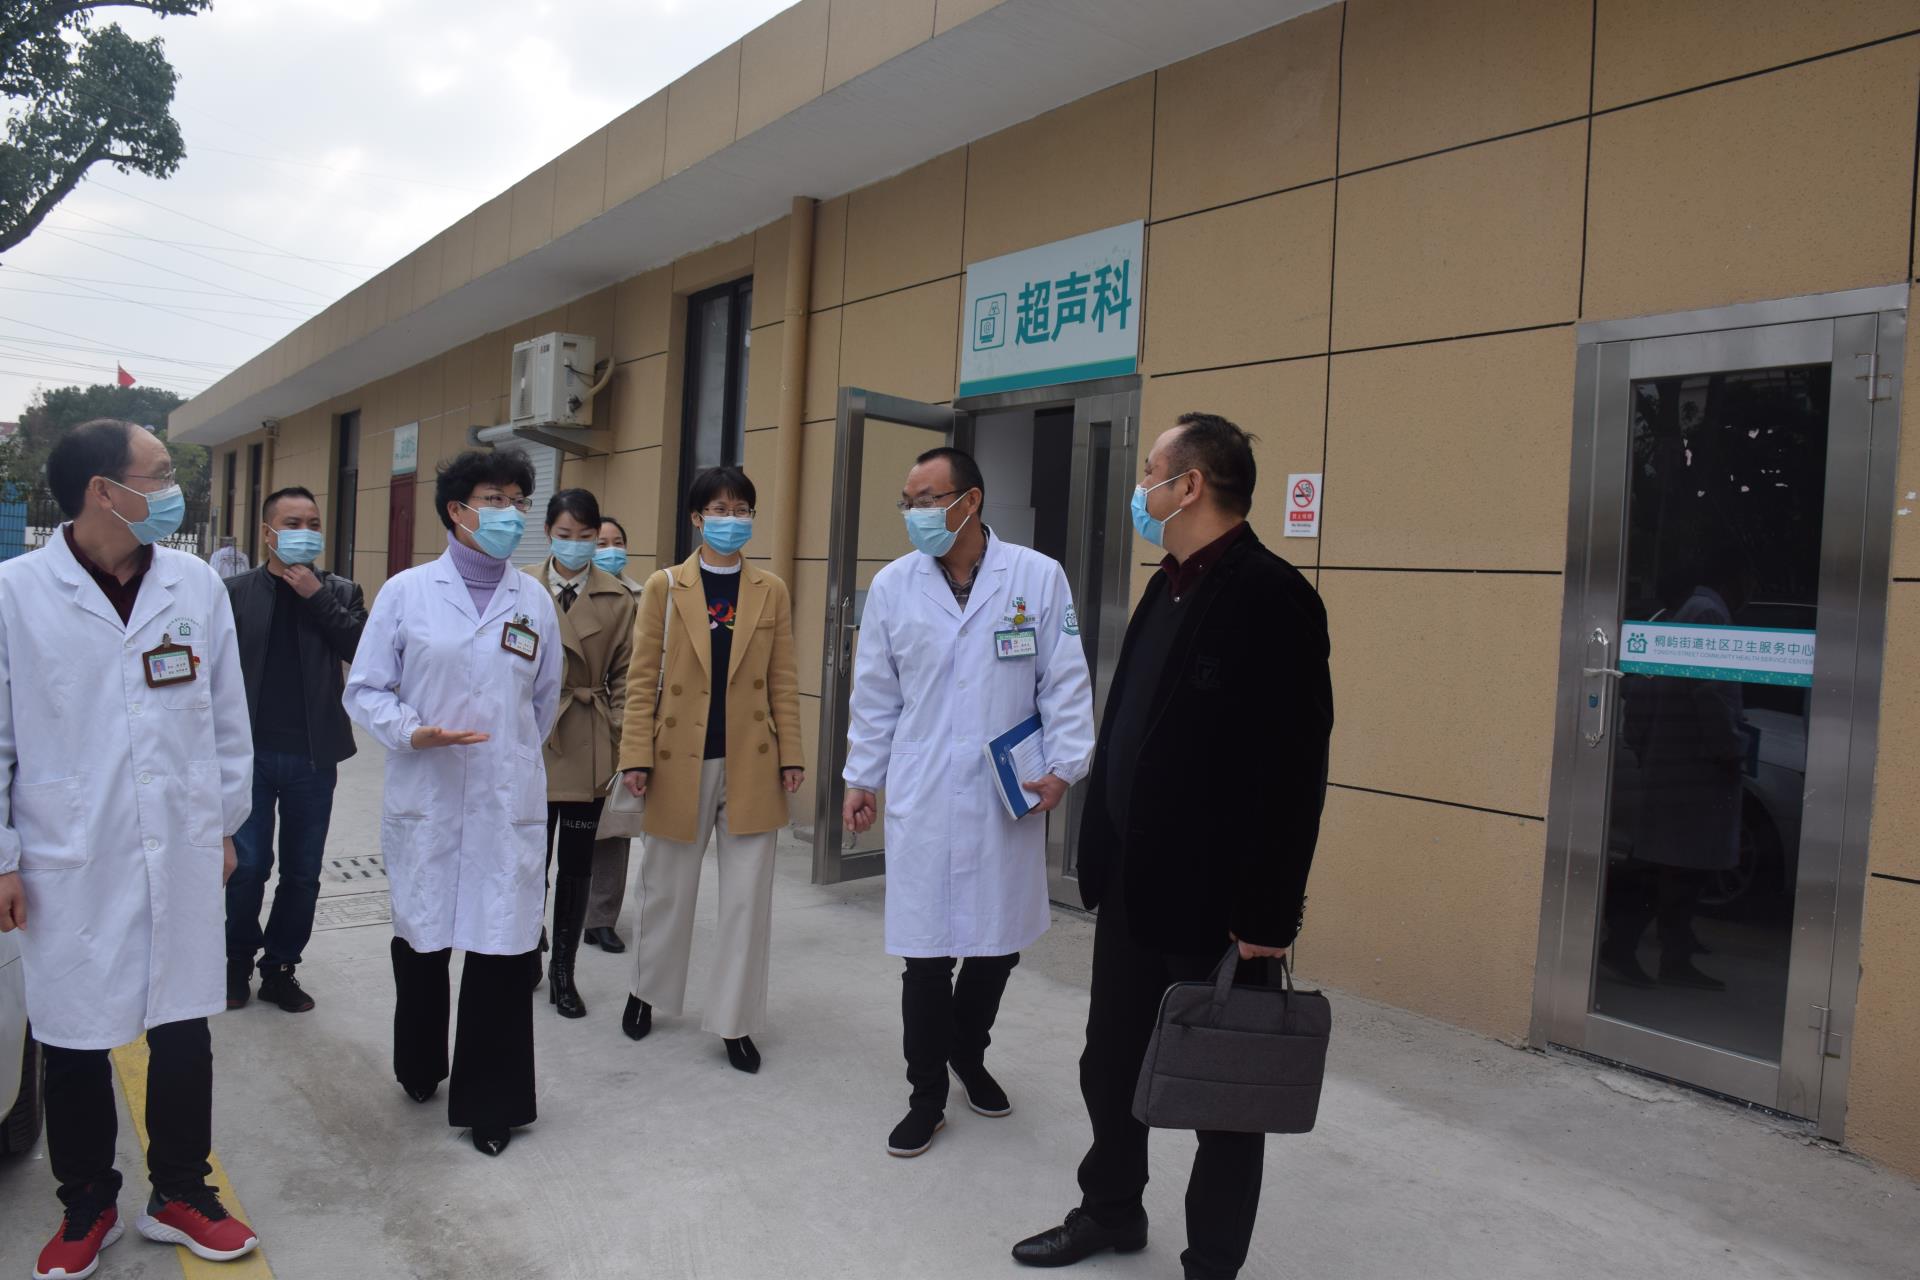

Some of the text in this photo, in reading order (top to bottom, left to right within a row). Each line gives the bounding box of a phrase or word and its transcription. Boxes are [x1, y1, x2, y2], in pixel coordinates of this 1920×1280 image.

[1015, 259, 1132, 345] 超声科
[1655, 635, 1814, 657] 桐屿街道社区卫生服务中心
